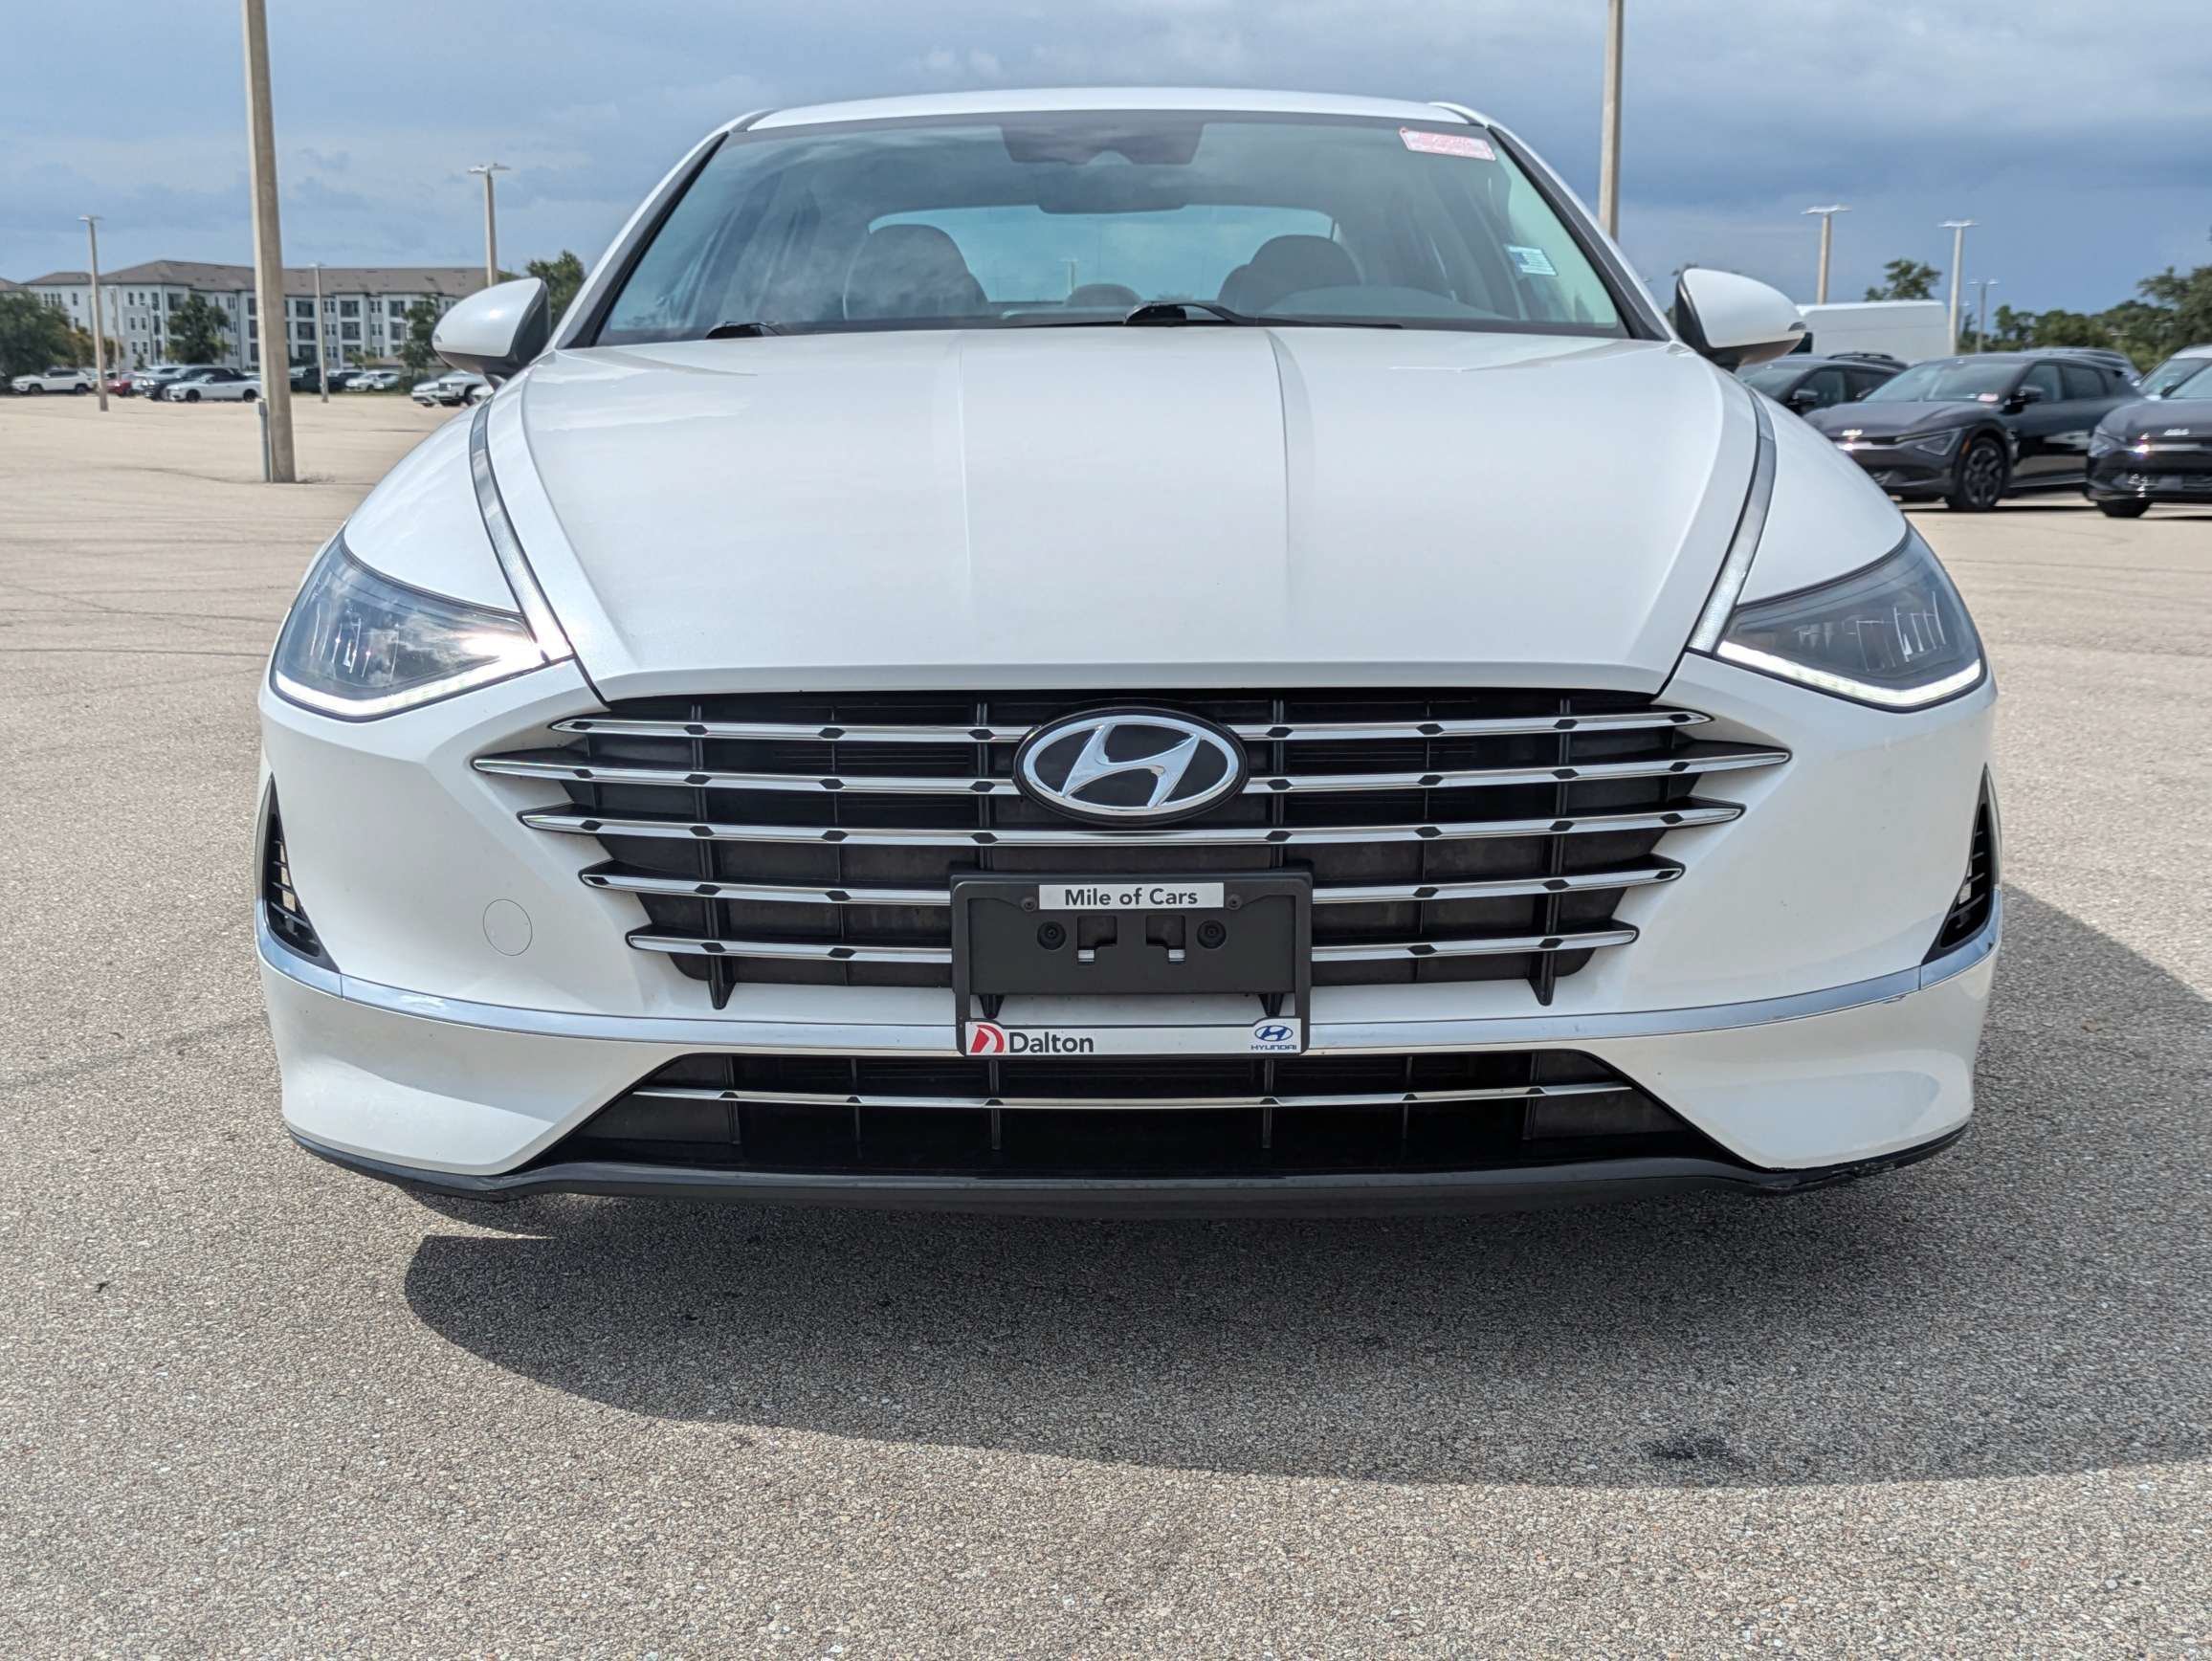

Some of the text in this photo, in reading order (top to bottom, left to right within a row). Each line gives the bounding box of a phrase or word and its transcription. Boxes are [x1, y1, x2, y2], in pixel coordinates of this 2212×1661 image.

[1064, 887, 1198, 906] Mile of Cars
[1008, 1031, 1095, 1053] Dalton
